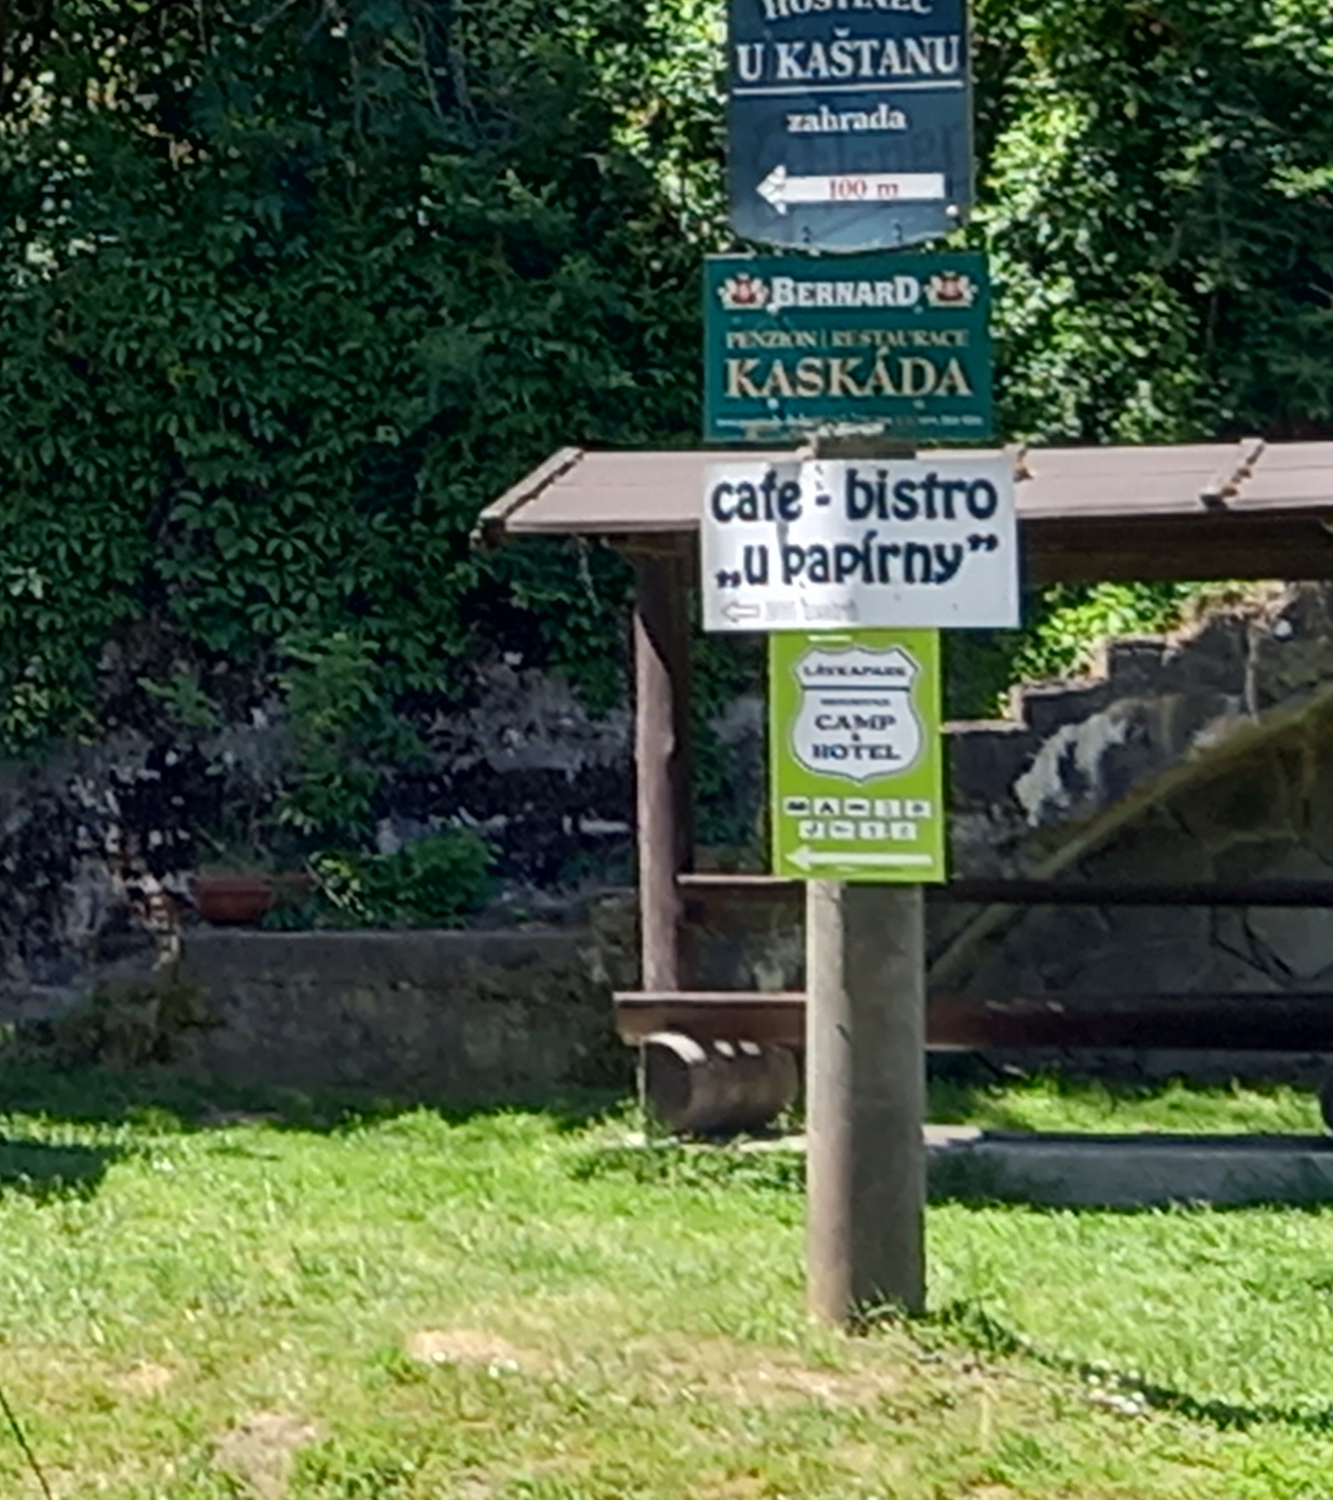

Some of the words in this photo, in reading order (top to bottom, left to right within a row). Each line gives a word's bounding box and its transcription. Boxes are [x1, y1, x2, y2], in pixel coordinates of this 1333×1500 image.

[737, 43, 765, 81] U
[777, 28, 961, 80] KAŠTANU
[787, 104, 907, 132] zahrada
[829, 178, 868, 199] 100
[770, 276, 921, 308] BERNARD
[725, 330, 818, 349] PENZION
[833, 328, 970, 348] RESTAURACE
[725, 346, 973, 397] KASKÁDA
[711, 470, 803, 523] cafe
[845, 468, 999, 522] bistro
[814, 714, 898, 731] CAMP
[811, 744, 904, 760] HOTEL
